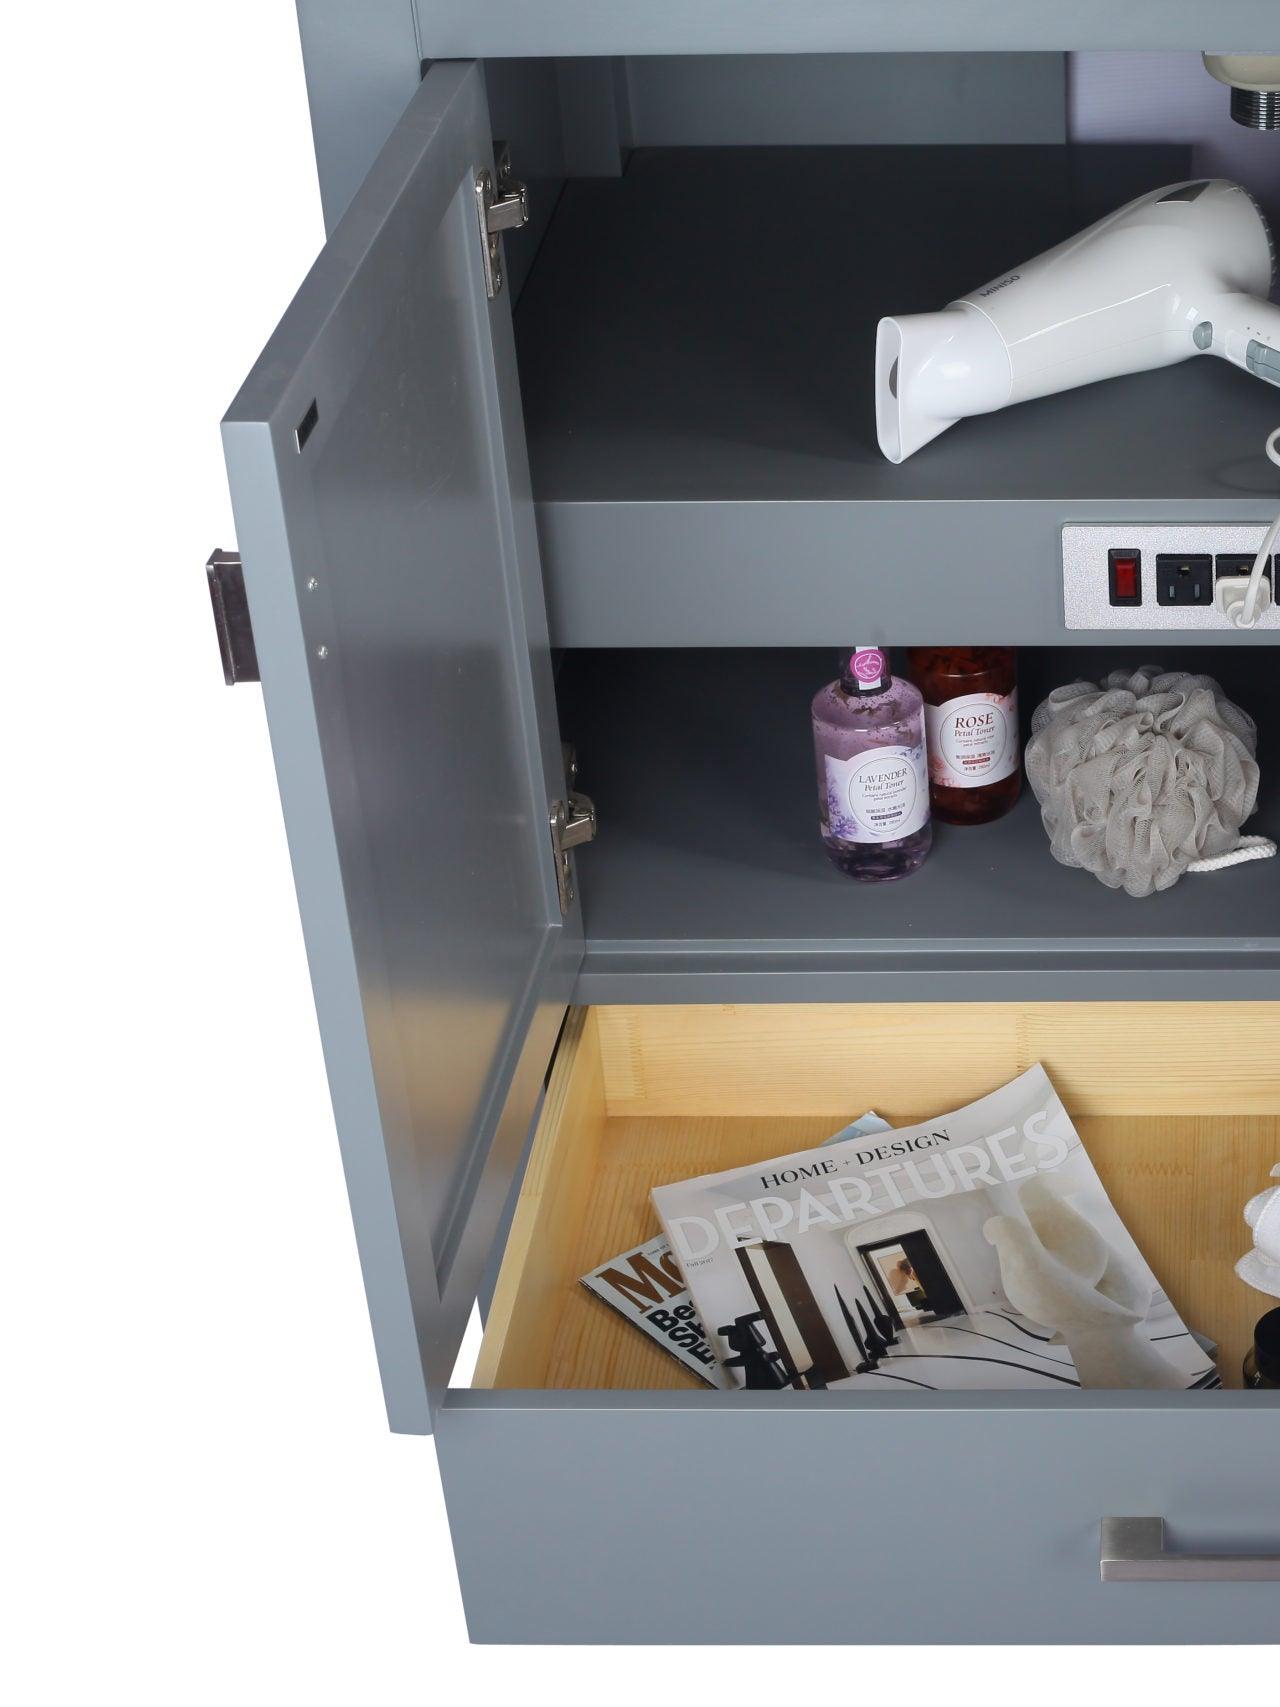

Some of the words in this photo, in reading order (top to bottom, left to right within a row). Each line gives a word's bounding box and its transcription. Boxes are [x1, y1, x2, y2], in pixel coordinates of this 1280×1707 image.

[955, 712, 994, 729] ROSE
[954, 728, 975, 737] Petal
[975, 726, 995, 736] Toner
[858, 767, 908, 784] LAVENDER
[864, 782, 883, 792] Petal
[885, 779, 905, 790] Toner
[760, 1160, 838, 1190] HOME
[858, 1128, 952, 1166] DESIGN
[667, 1109, 1070, 1261] DEPARTURES
[646, 1299, 697, 1333] Be
